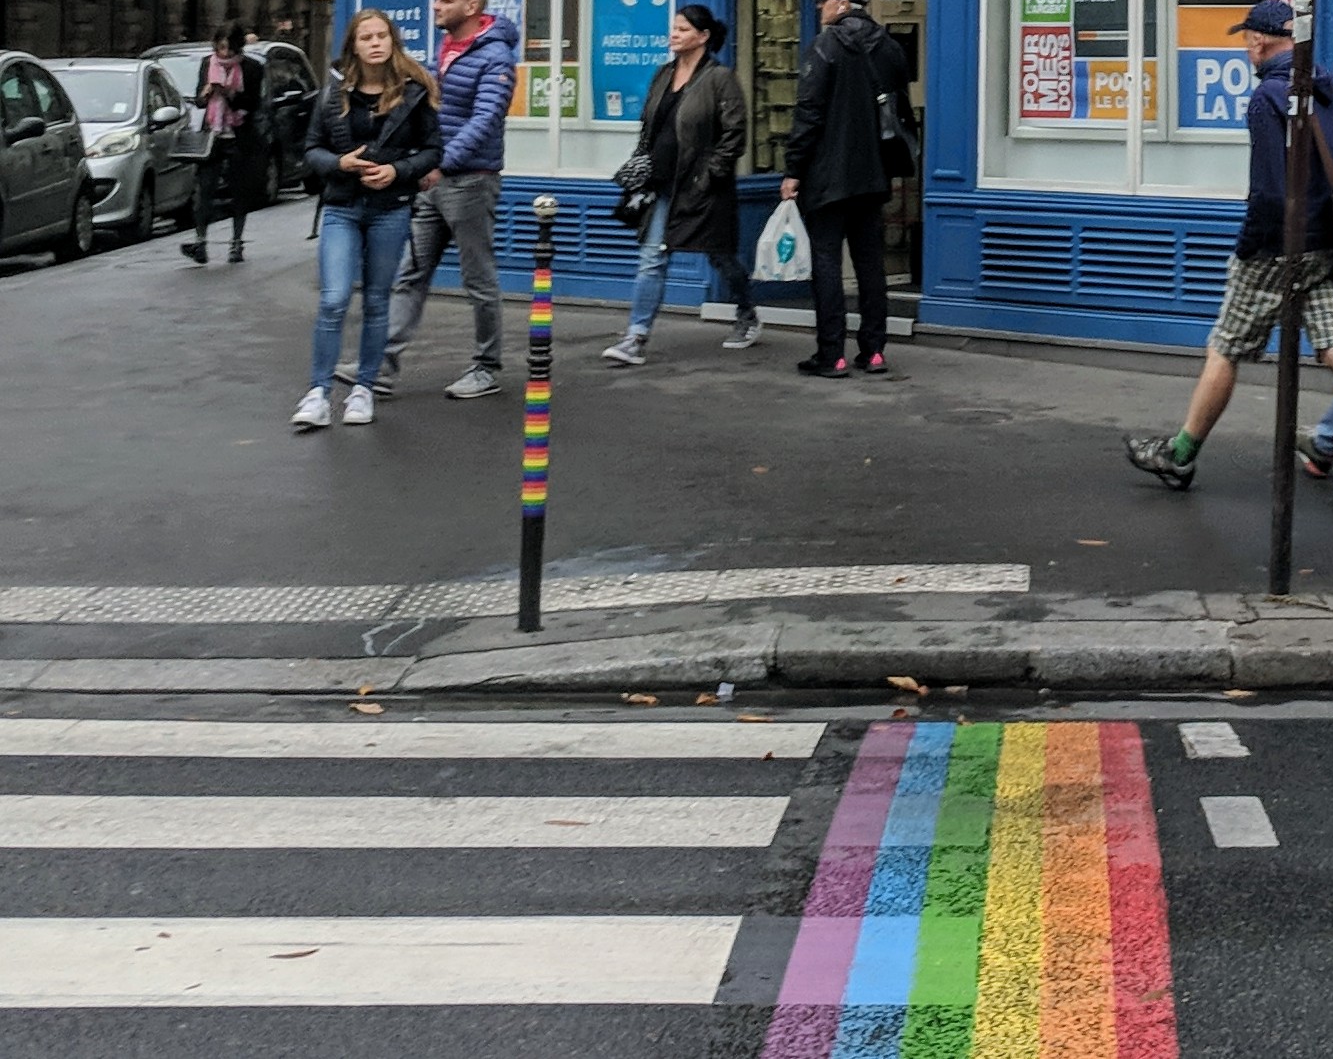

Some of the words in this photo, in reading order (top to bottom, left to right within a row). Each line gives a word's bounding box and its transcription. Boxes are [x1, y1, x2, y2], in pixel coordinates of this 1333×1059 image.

[387, 6, 421, 21] vert
[633, 35, 648, 48] DU
[604, 52, 640, 66] BESOIN
[1023, 34, 1040, 111] POUR
[1039, 34, 1058, 111] MES
[1057, 34, 1071, 111] DOIGTS
[1095, 95, 1113, 108] LE
[1196, 96, 1230, 120] LA
